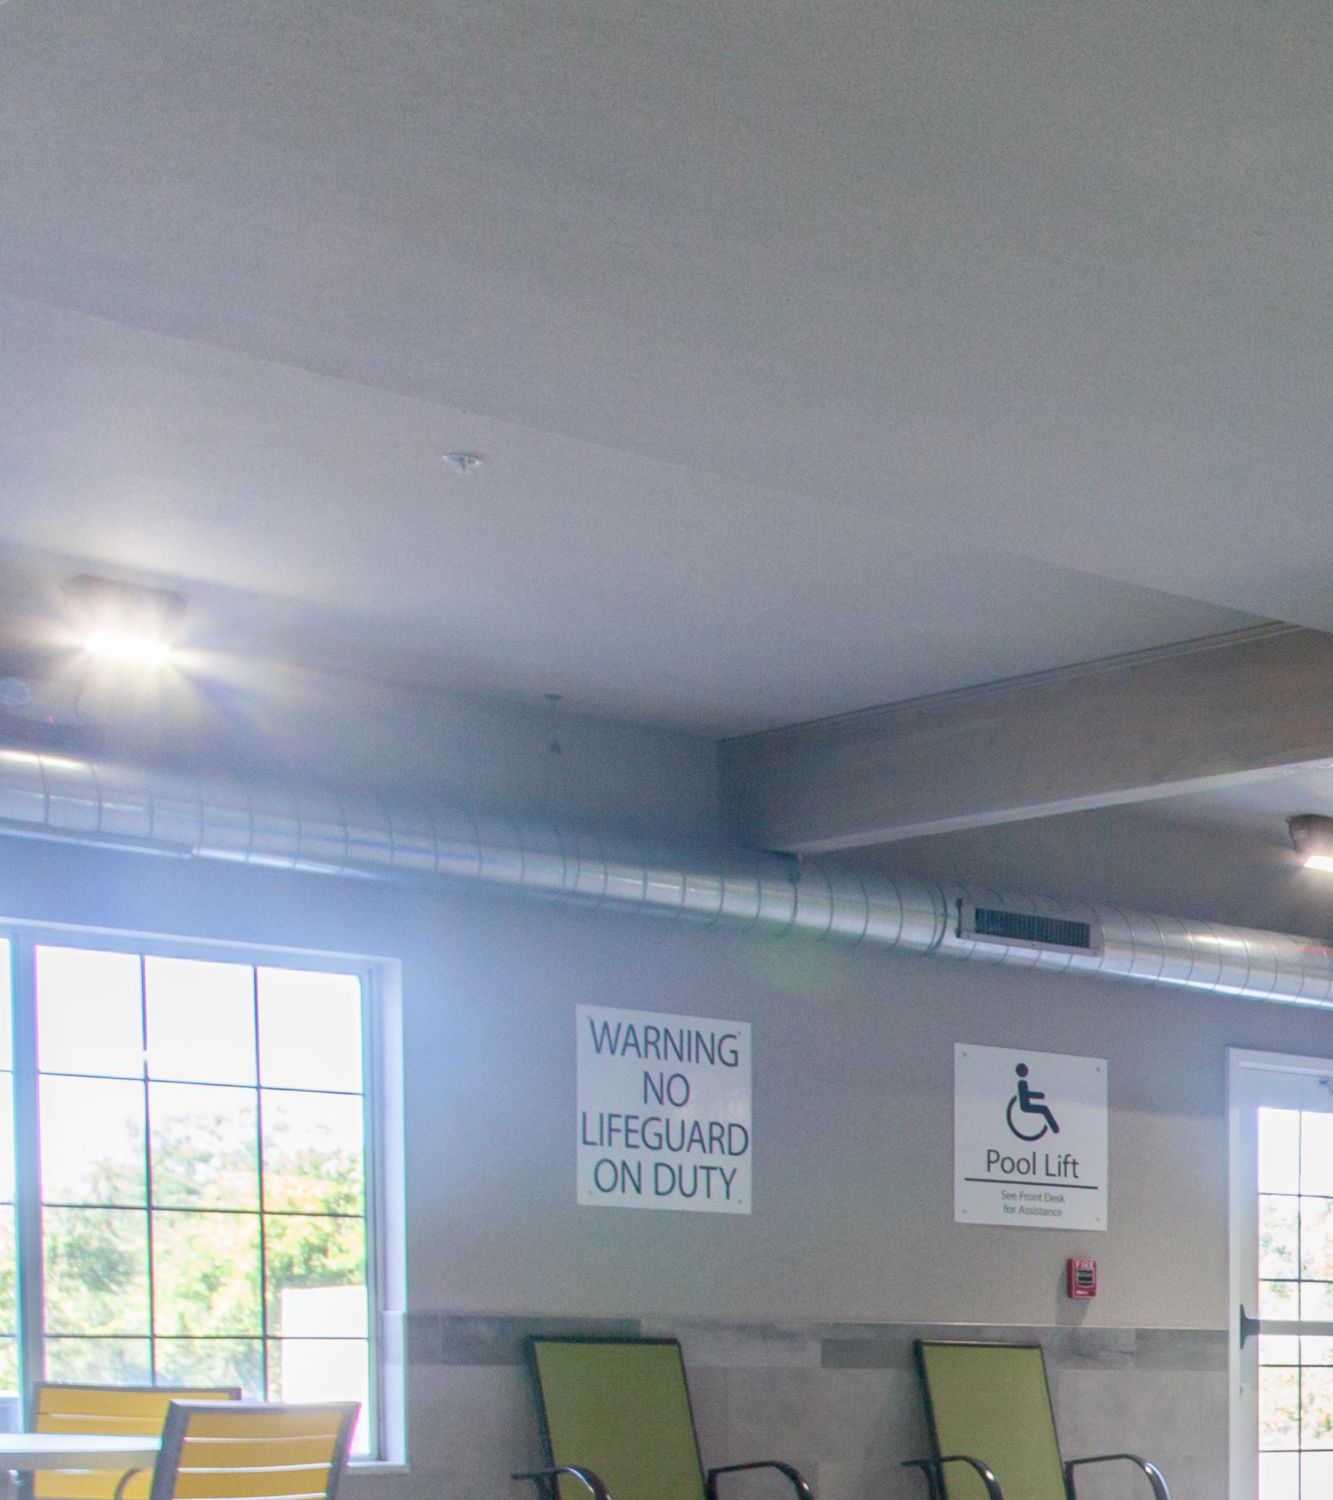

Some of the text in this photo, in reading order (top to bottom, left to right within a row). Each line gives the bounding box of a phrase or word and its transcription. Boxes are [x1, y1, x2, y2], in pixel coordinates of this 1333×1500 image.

[589, 1019, 739, 1068] WARNING
[643, 1070, 690, 1107] NO
[582, 1111, 749, 1156] LIFEGUARD
[594, 1158, 737, 1200] ON DUTY
[987, 1148, 1079, 1179] Pool Lift
[1001, 1190, 1065, 1203] See Front Desk
[1003, 1203, 1062, 1217] for Assistance
